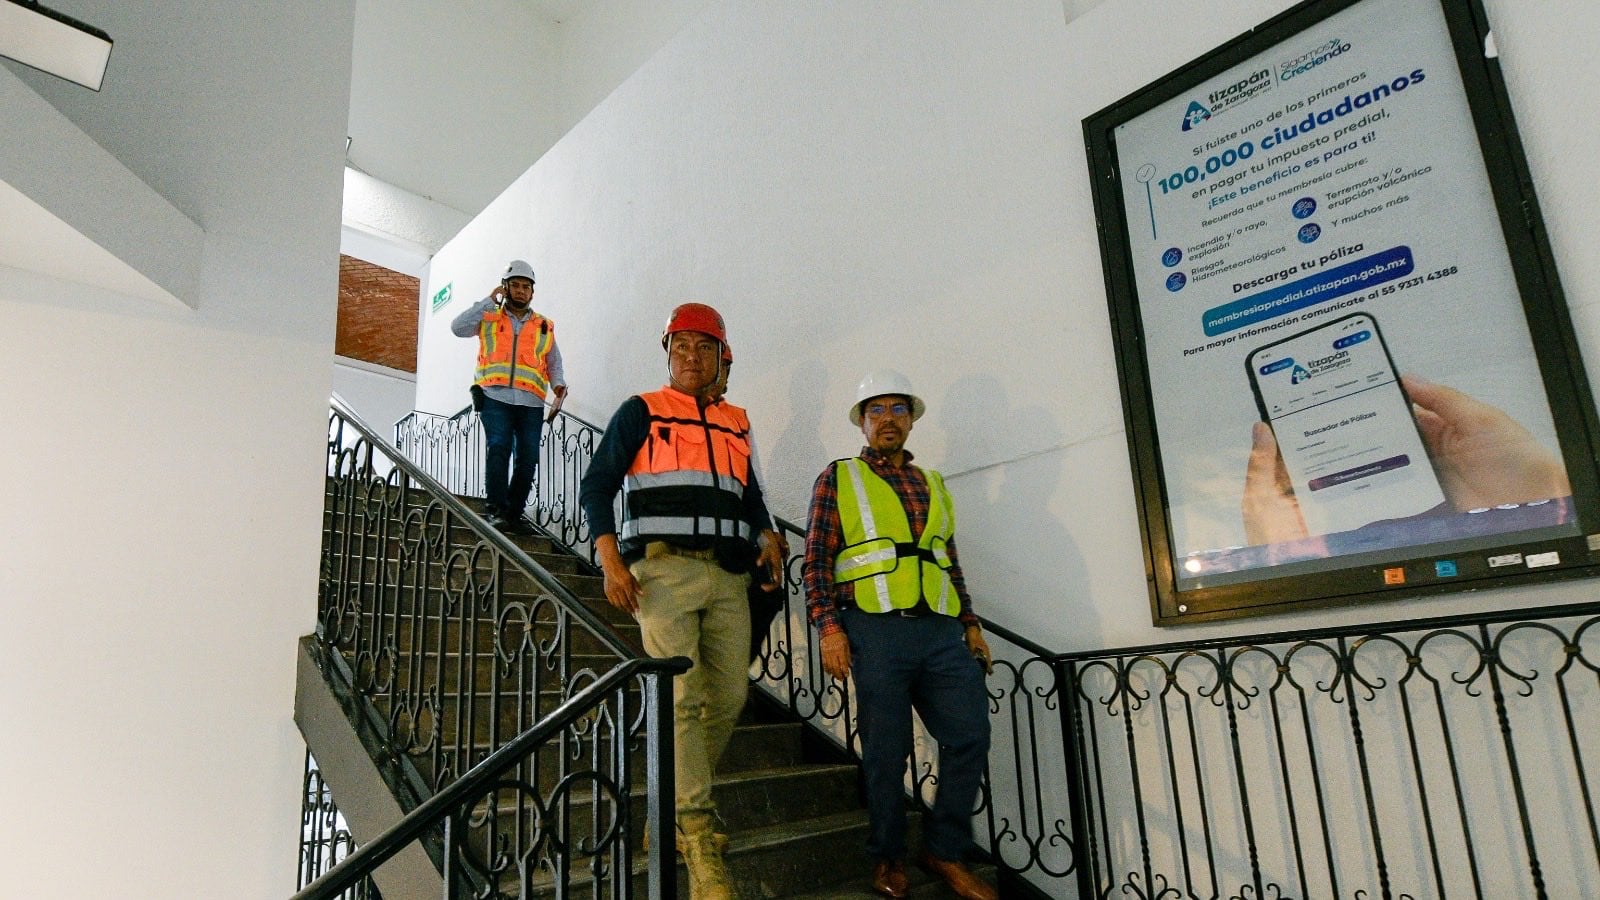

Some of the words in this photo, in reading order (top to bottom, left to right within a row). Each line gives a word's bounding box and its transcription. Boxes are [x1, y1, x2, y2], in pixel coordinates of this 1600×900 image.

[1281, 42, 1351, 81] Creciendo
[1193, 146, 1204, 156] Si
[1205, 131, 1237, 151] fuiste
[1240, 120, 1263, 134] uno
[1267, 111, 1283, 122] de
[1285, 101, 1304, 114] los
[1308, 72, 1367, 106] primeros
[1211, 100, 1225, 114] de
[1225, 80, 1271, 109] Zaragoza
[1158, 142, 1254, 194] 100,000
[1261, 68, 1426, 150] ciudadanos
[1192, 187, 1206, 200] en
[1209, 170, 1247, 198] pagar
[1250, 162, 1264, 174] tu
[1268, 136, 1330, 170] impuesto
[1334, 108, 1391, 141] predial,
[1208, 190, 1237, 210] ¡Este
[1240, 164, 1300, 194] beneficio
[1304, 157, 1320, 169] es
[1323, 141, 1358, 163] para
[1361, 131, 1376, 147] ti!
[1202, 207, 1244, 227] Recuerda
[1247, 199, 1263, 213] que
[1266, 194, 1276, 204] tu
[1278, 168, 1332, 200] membresía
[1334, 156, 1368, 177] cubre:
[1326, 175, 1379, 200] Terremoto
[1382, 167, 1402, 182] y/o
[1328, 187, 1374, 211] erupción
[1377, 166, 1432, 191] volcánica
[1331, 219, 1338, 227] Y
[1341, 204, 1383, 225] muchos
[1386, 194, 1409, 211] más
[1187, 233, 1223, 252] Incendio
[1226, 225, 1244, 239] y/o
[1246, 219, 1268, 234] rayo,
[1189, 241, 1230, 261] explosión
[1191, 257, 1224, 275] Riesgos
[1192, 246, 1286, 284] Hidrometeorológicos
[1233, 265, 1298, 294] Descarga
[1301, 258, 1316, 270] tu
[1319, 241, 1363, 267] póliza
[1183, 346, 1204, 356] Para
[1207, 335, 1236, 351] mayor
[1238, 315, 1299, 340] información
[1368, 290, 1379, 300] al
[1382, 285, 1396, 296] 55
[1398, 277, 1424, 292] 9331
[1427, 265, 1458, 281] 4388
[1209, 256, 1406, 328] membresiapredial.atizapan.gob.mx
[1304, 421, 1338, 438] Buscador
[1340, 418, 1349, 426] de
